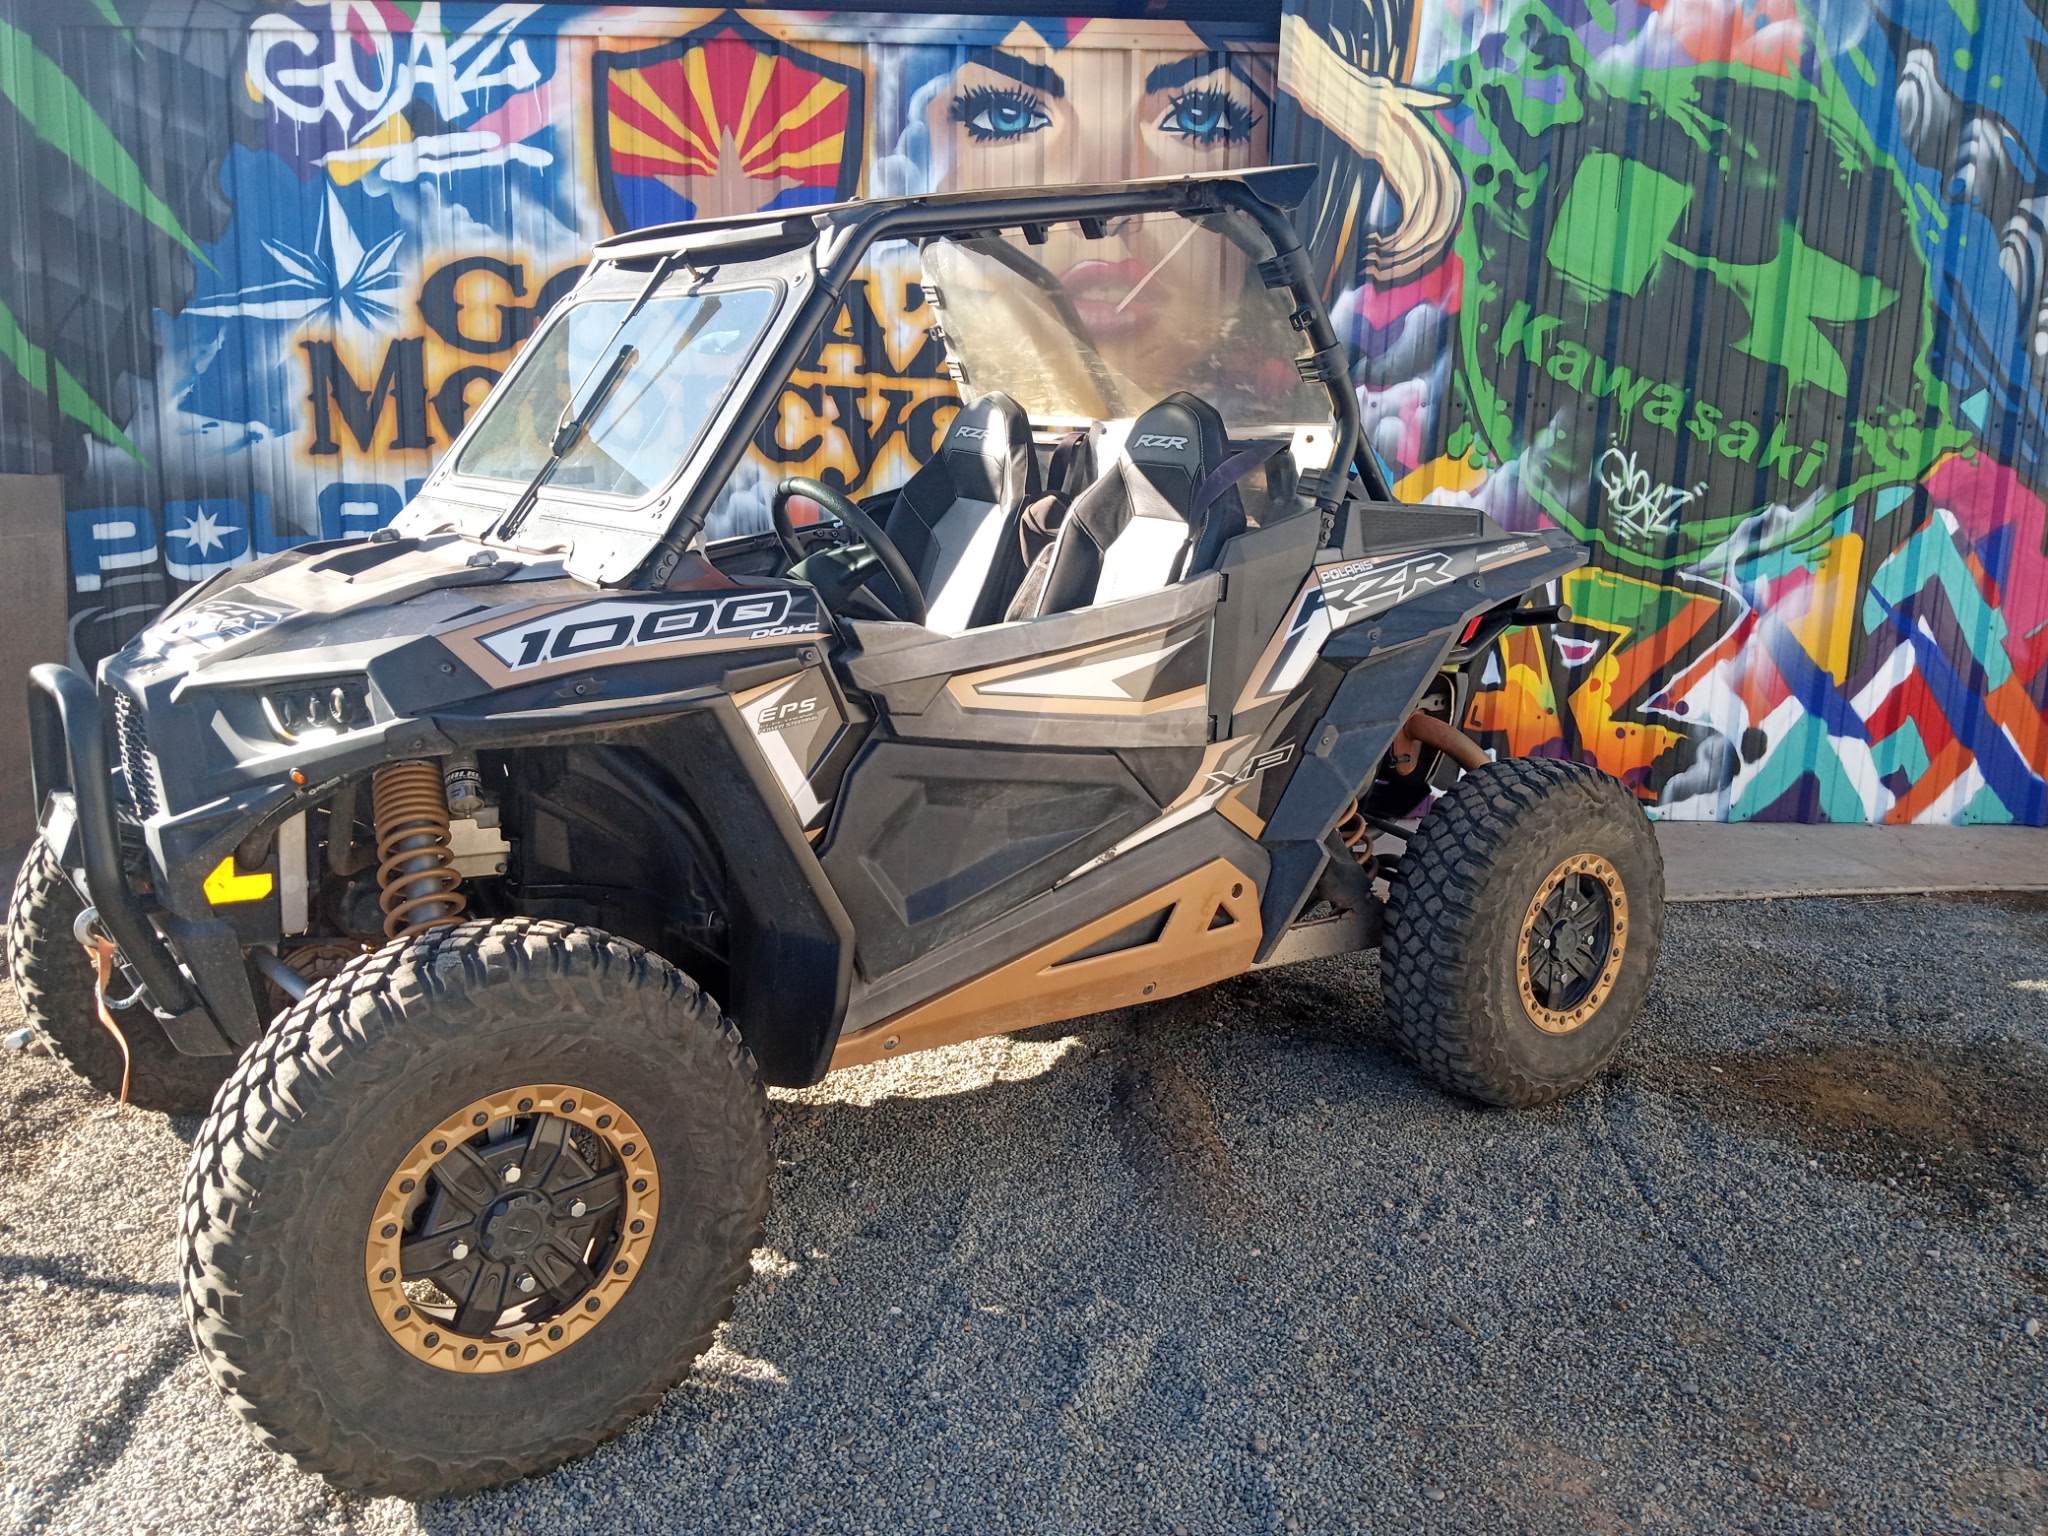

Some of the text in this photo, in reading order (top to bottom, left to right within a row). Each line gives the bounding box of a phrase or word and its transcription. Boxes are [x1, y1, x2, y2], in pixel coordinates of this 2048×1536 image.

[1495, 299, 1829, 488] Kawasaki
[1134, 434, 1189, 450] RZR
[65, 478, 426, 593] POLA
[1283, 552, 1457, 640] RZR
[1320, 560, 1374, 582] POLARIS
[510, 591, 791, 671] 1000
[749, 622, 820, 640] DOHC
[758, 697, 818, 723] EPS
[1203, 743, 1296, 798] XP
